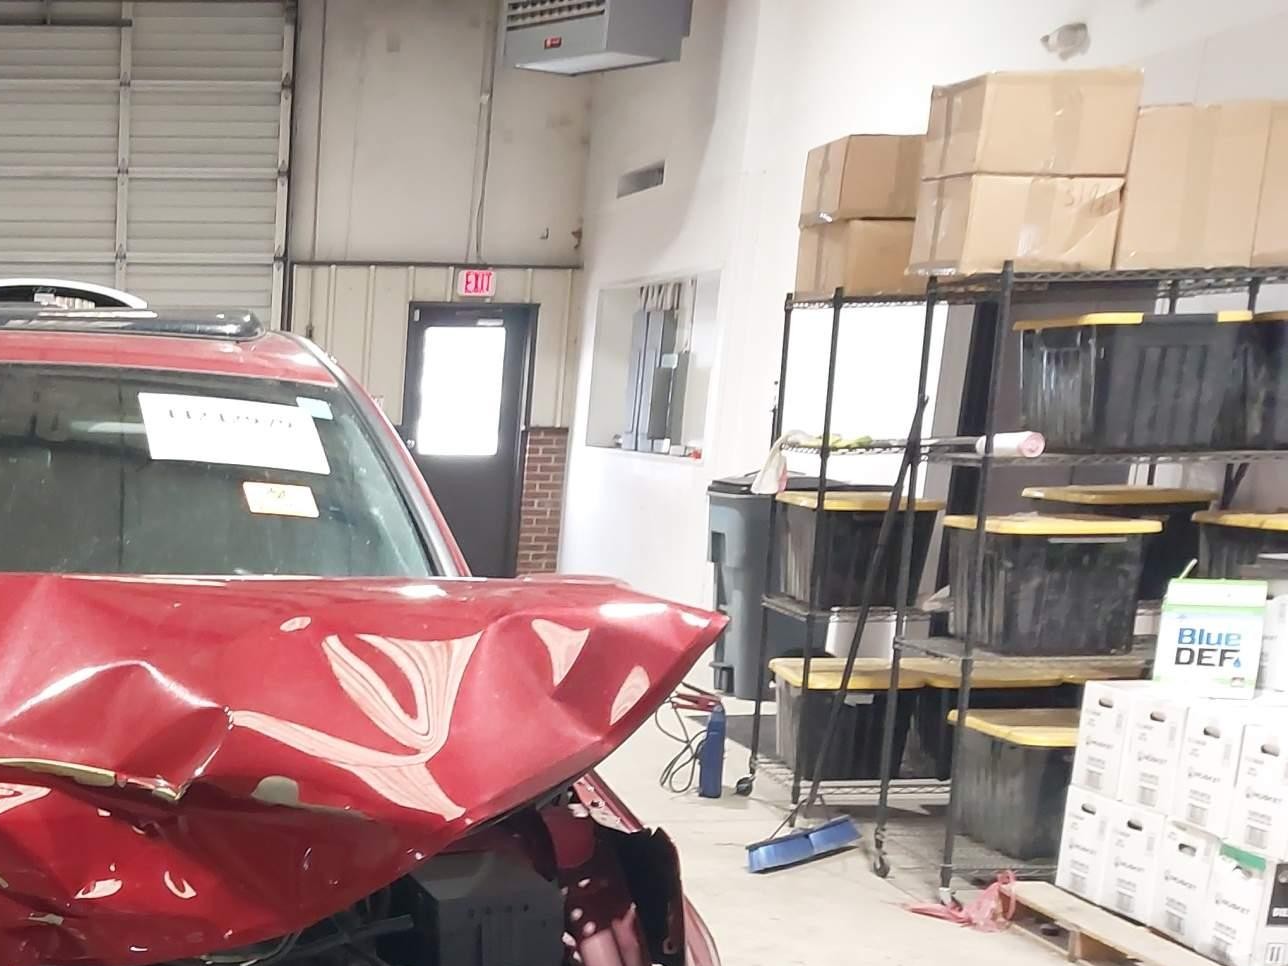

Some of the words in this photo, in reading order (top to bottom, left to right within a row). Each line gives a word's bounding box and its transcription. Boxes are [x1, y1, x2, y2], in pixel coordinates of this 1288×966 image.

[464, 271, 493, 293] EXIT
[1177, 627, 1242, 647] Blue
[1174, 647, 1241, 667] DEF
